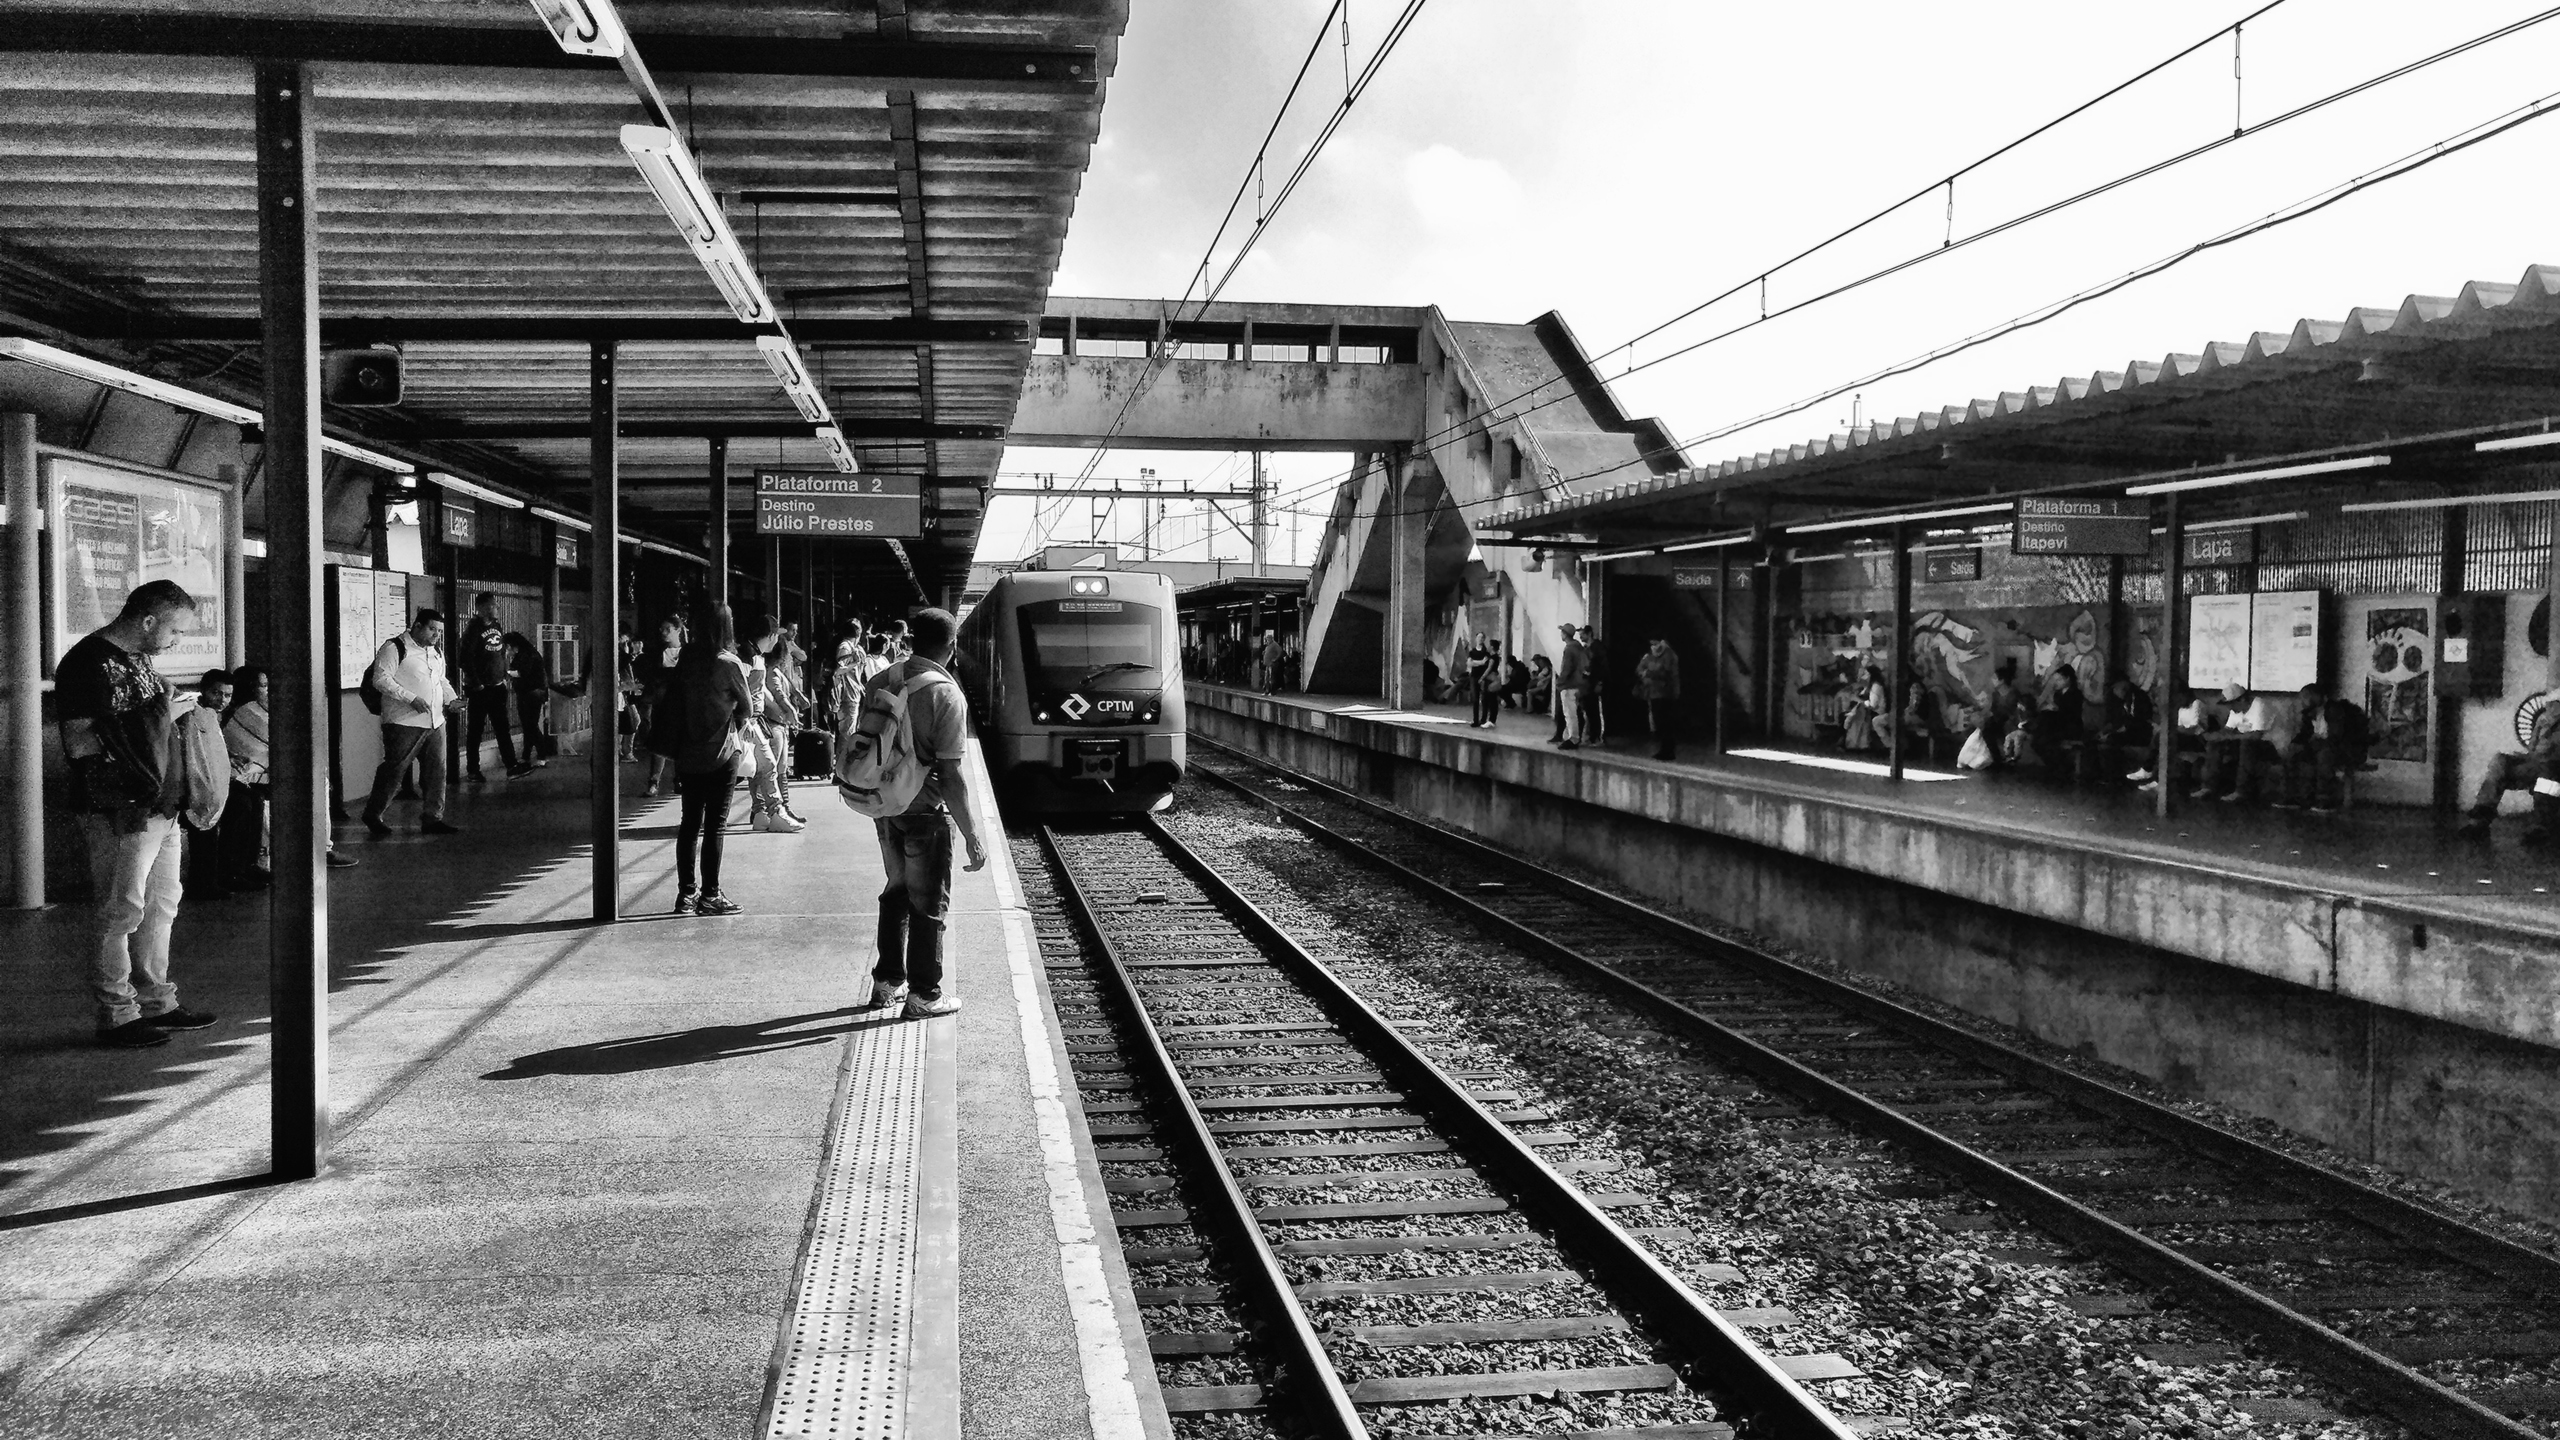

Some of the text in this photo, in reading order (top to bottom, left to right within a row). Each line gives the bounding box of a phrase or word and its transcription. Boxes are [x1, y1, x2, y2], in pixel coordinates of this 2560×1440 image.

[762, 475, 883, 492] Plataforma 2
[762, 499, 815, 512] Destino
[2022, 500, 2118, 514] Plataforma 1
[450, 510, 469, 542] Lapa
[762, 514, 874, 531] Júlio Prestes
[2021, 521, 2065, 532] Destino
[2021, 535, 2067, 551] Itapevi
[2192, 538, 2232, 563] Lapa
[1097, 700, 1134, 712] CPTM
